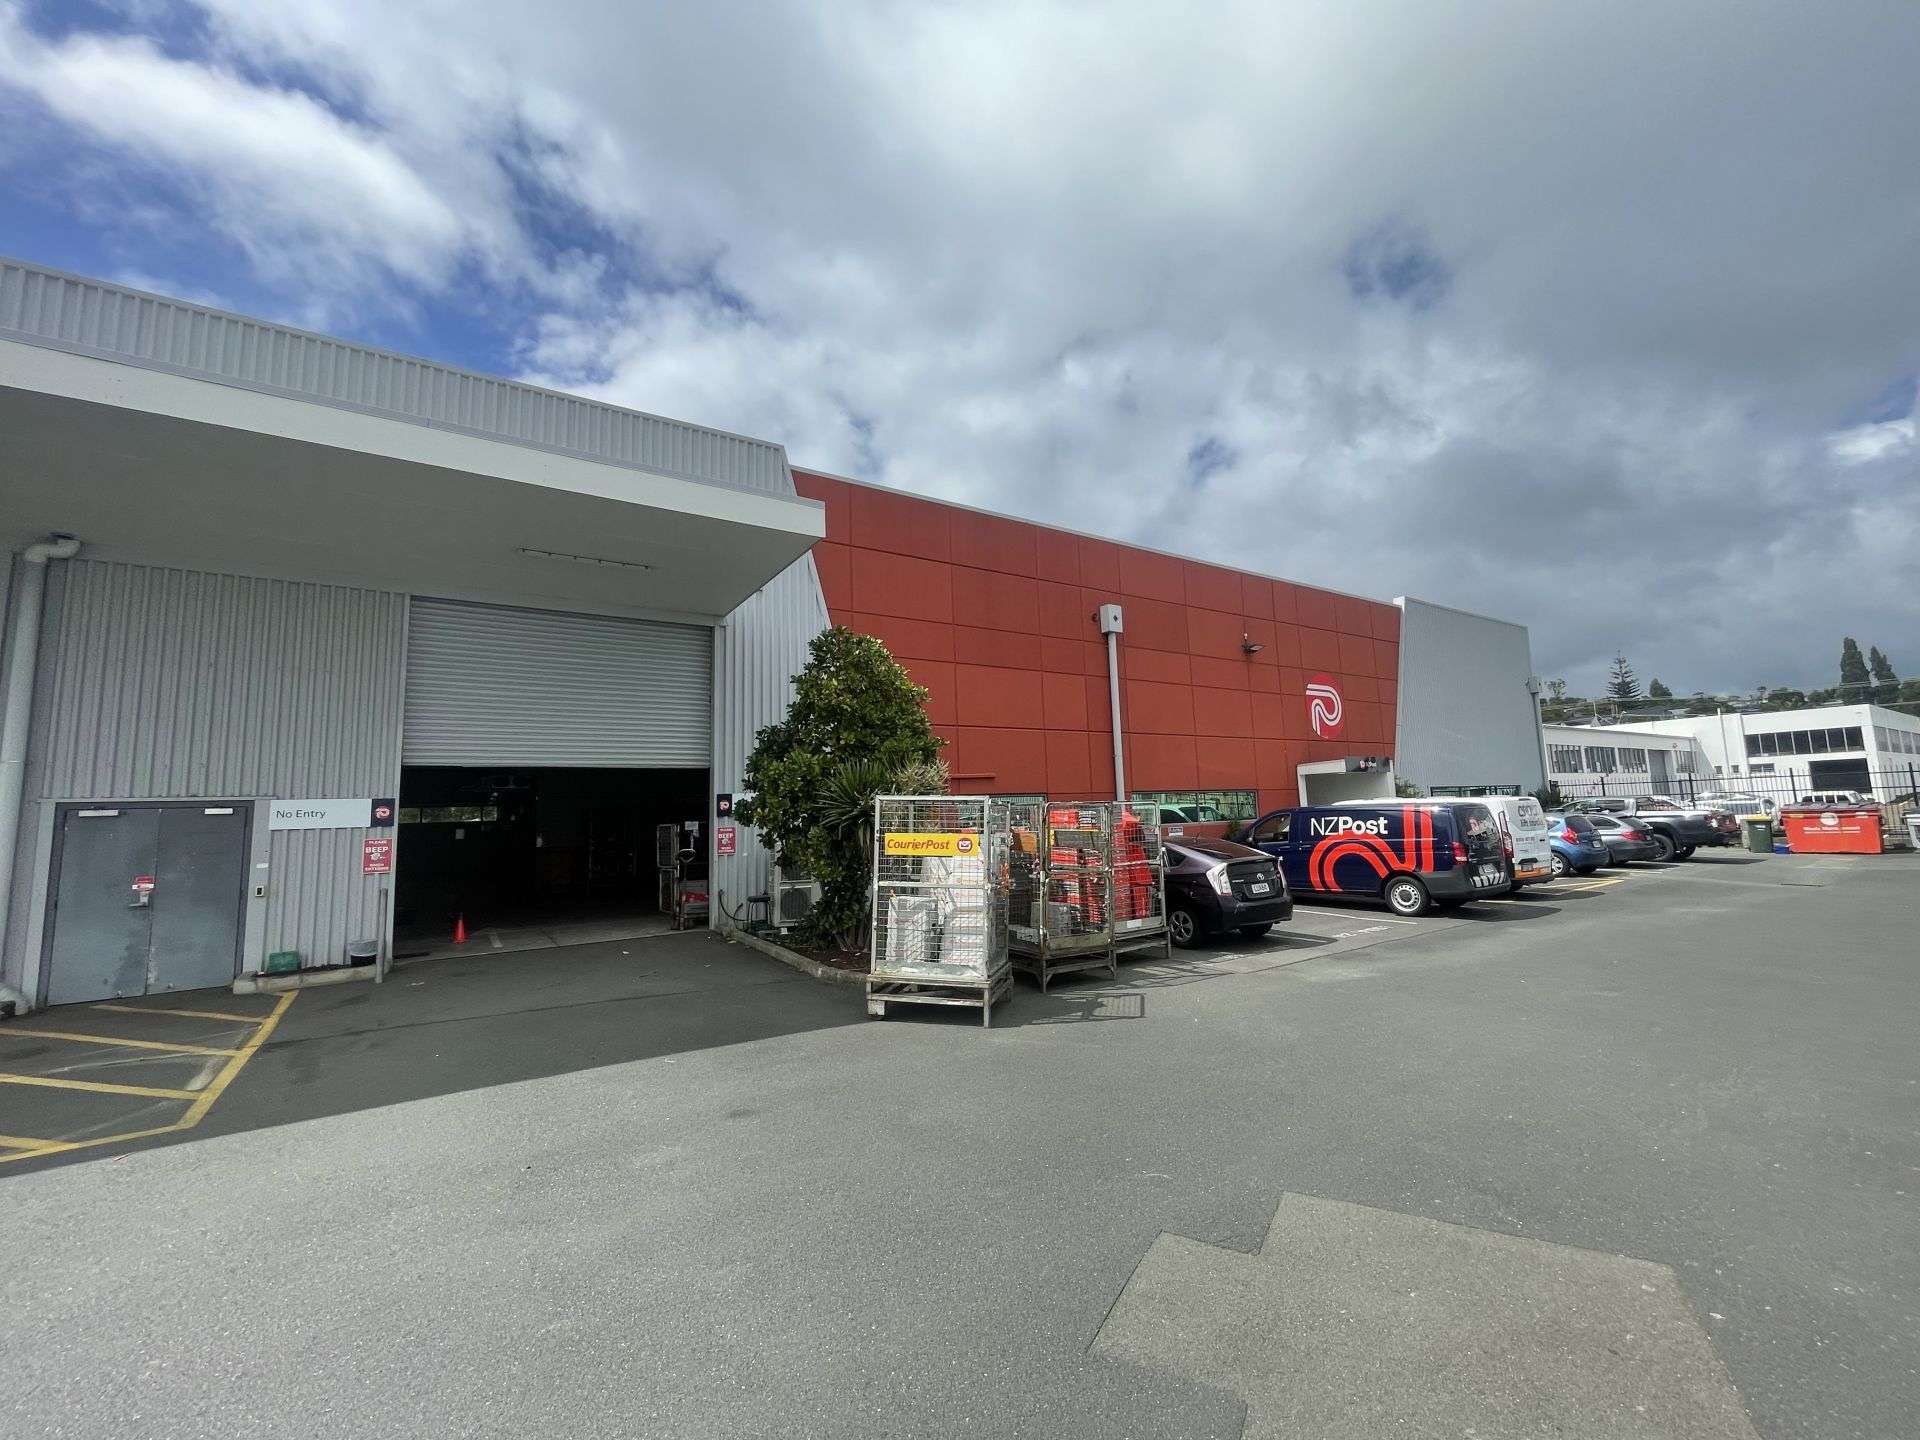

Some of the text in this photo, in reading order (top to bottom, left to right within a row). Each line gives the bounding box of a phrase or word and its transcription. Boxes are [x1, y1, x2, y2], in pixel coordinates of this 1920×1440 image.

[276, 810, 327, 819] No Entry
[1310, 816, 1389, 836] NZPost
[887, 838, 950, 850] CourierPost
